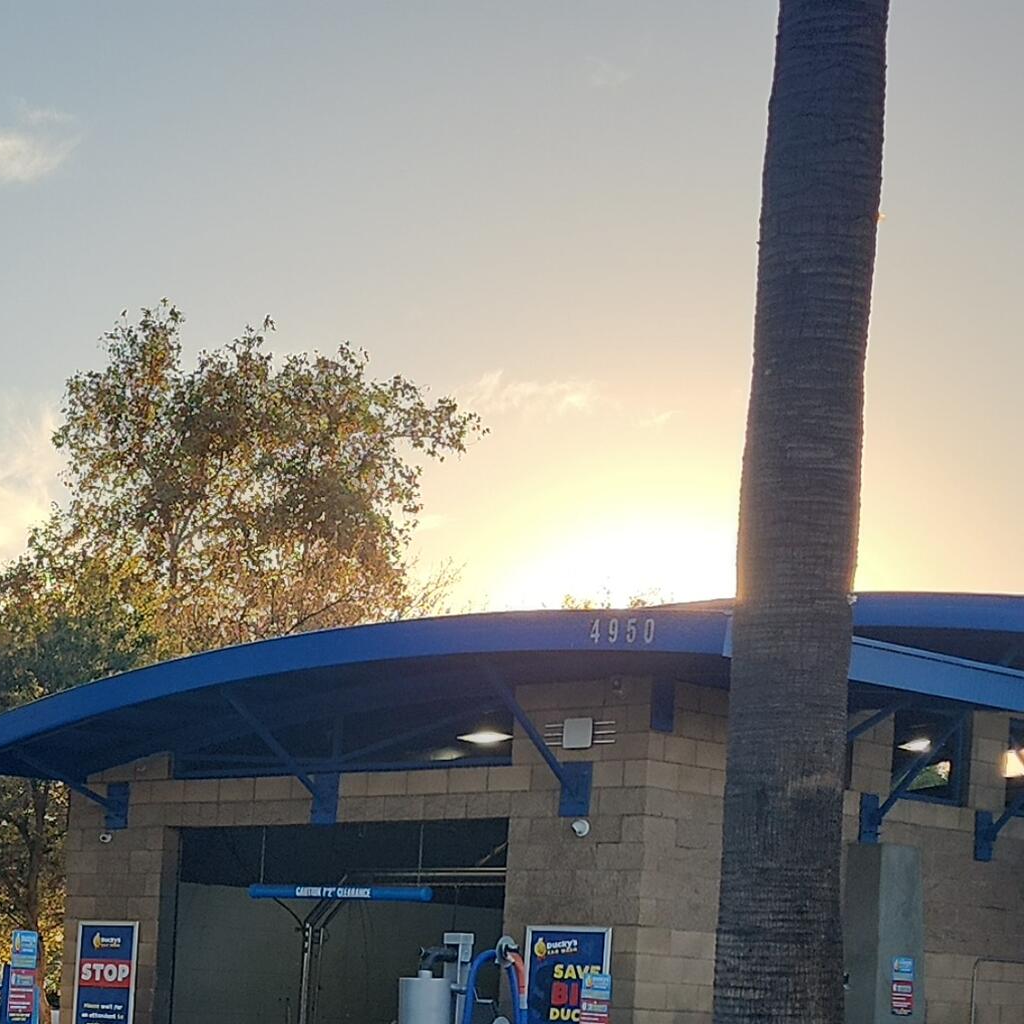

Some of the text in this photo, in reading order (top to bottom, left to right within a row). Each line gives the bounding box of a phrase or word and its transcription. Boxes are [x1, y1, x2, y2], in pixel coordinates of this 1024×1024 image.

[590, 618, 655, 643] 4950
[547, 940, 578, 950] Ducky's
[81, 962, 129, 982] STOP
[551, 982, 579, 1006] BI
